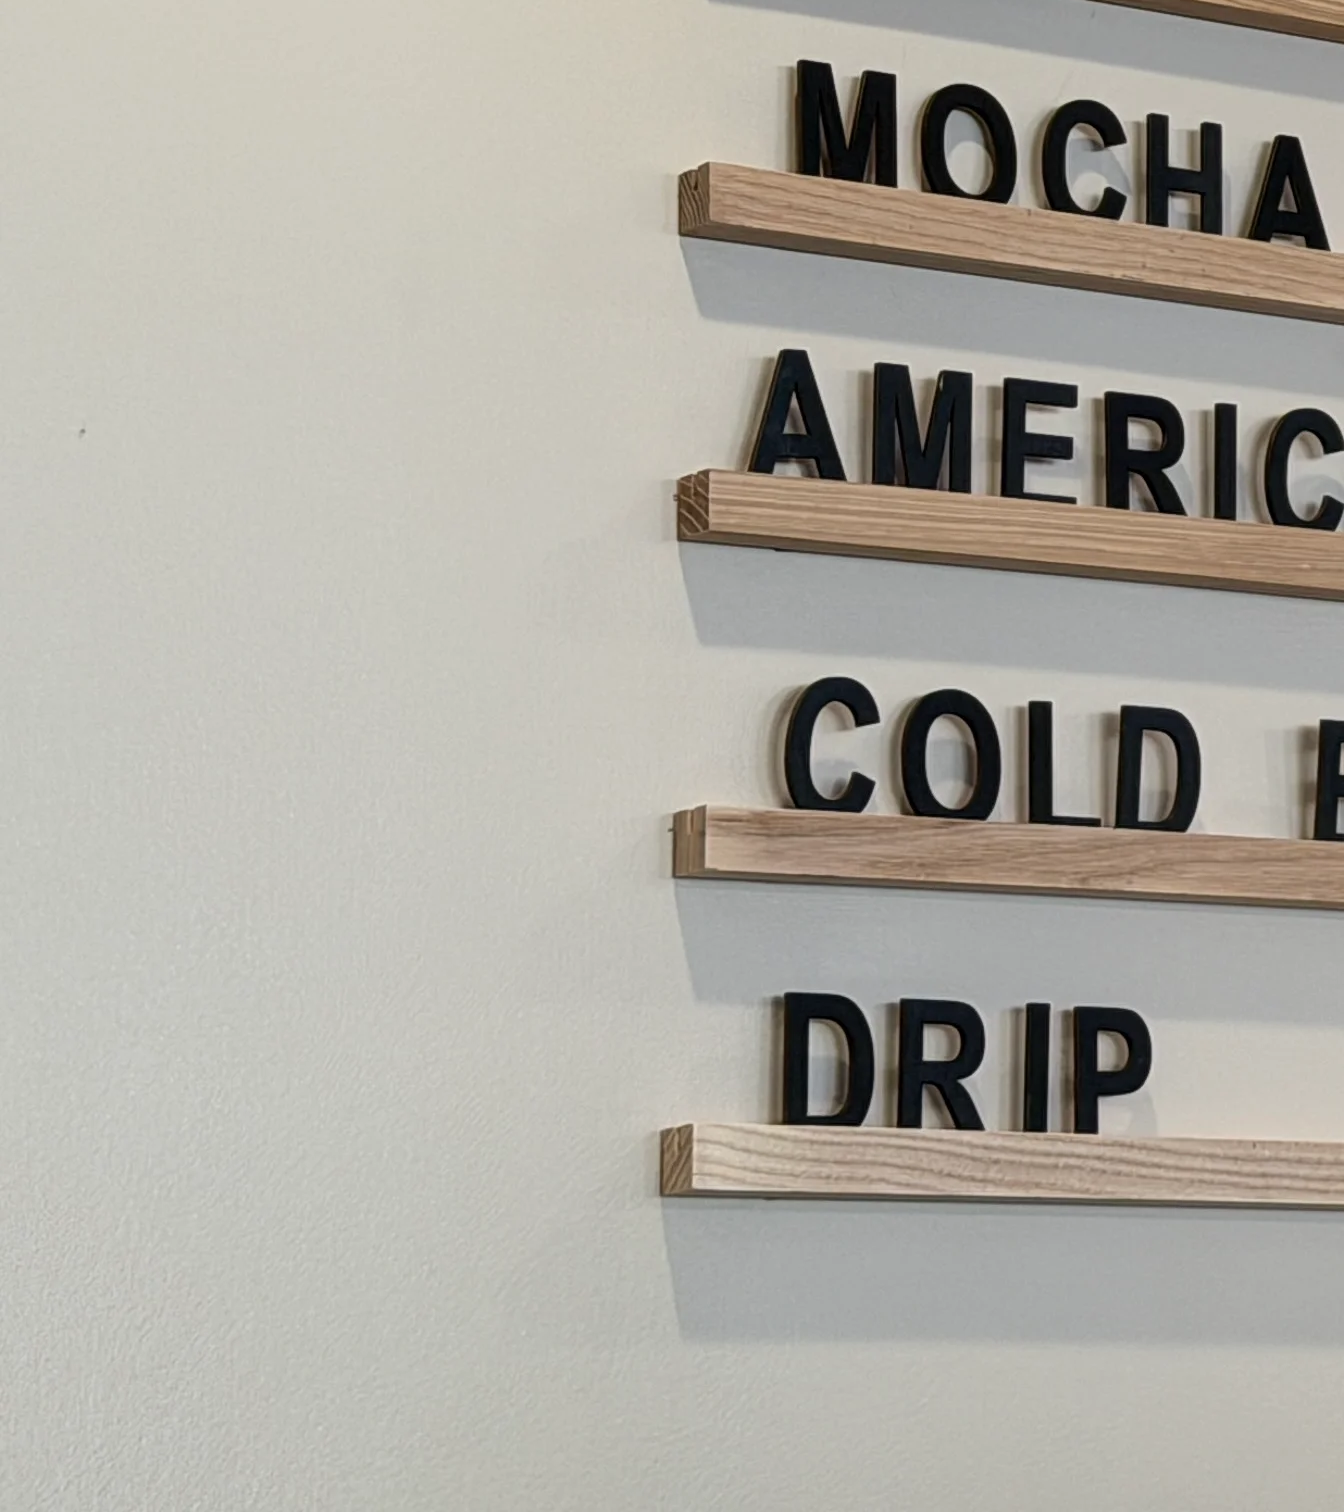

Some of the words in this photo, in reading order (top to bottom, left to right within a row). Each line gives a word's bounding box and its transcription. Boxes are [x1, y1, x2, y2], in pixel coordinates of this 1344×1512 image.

[796, 60, 1331, 252] MOCHA
[783, 676, 1202, 834] COLD
[779, 991, 1153, 1136] DRIP
